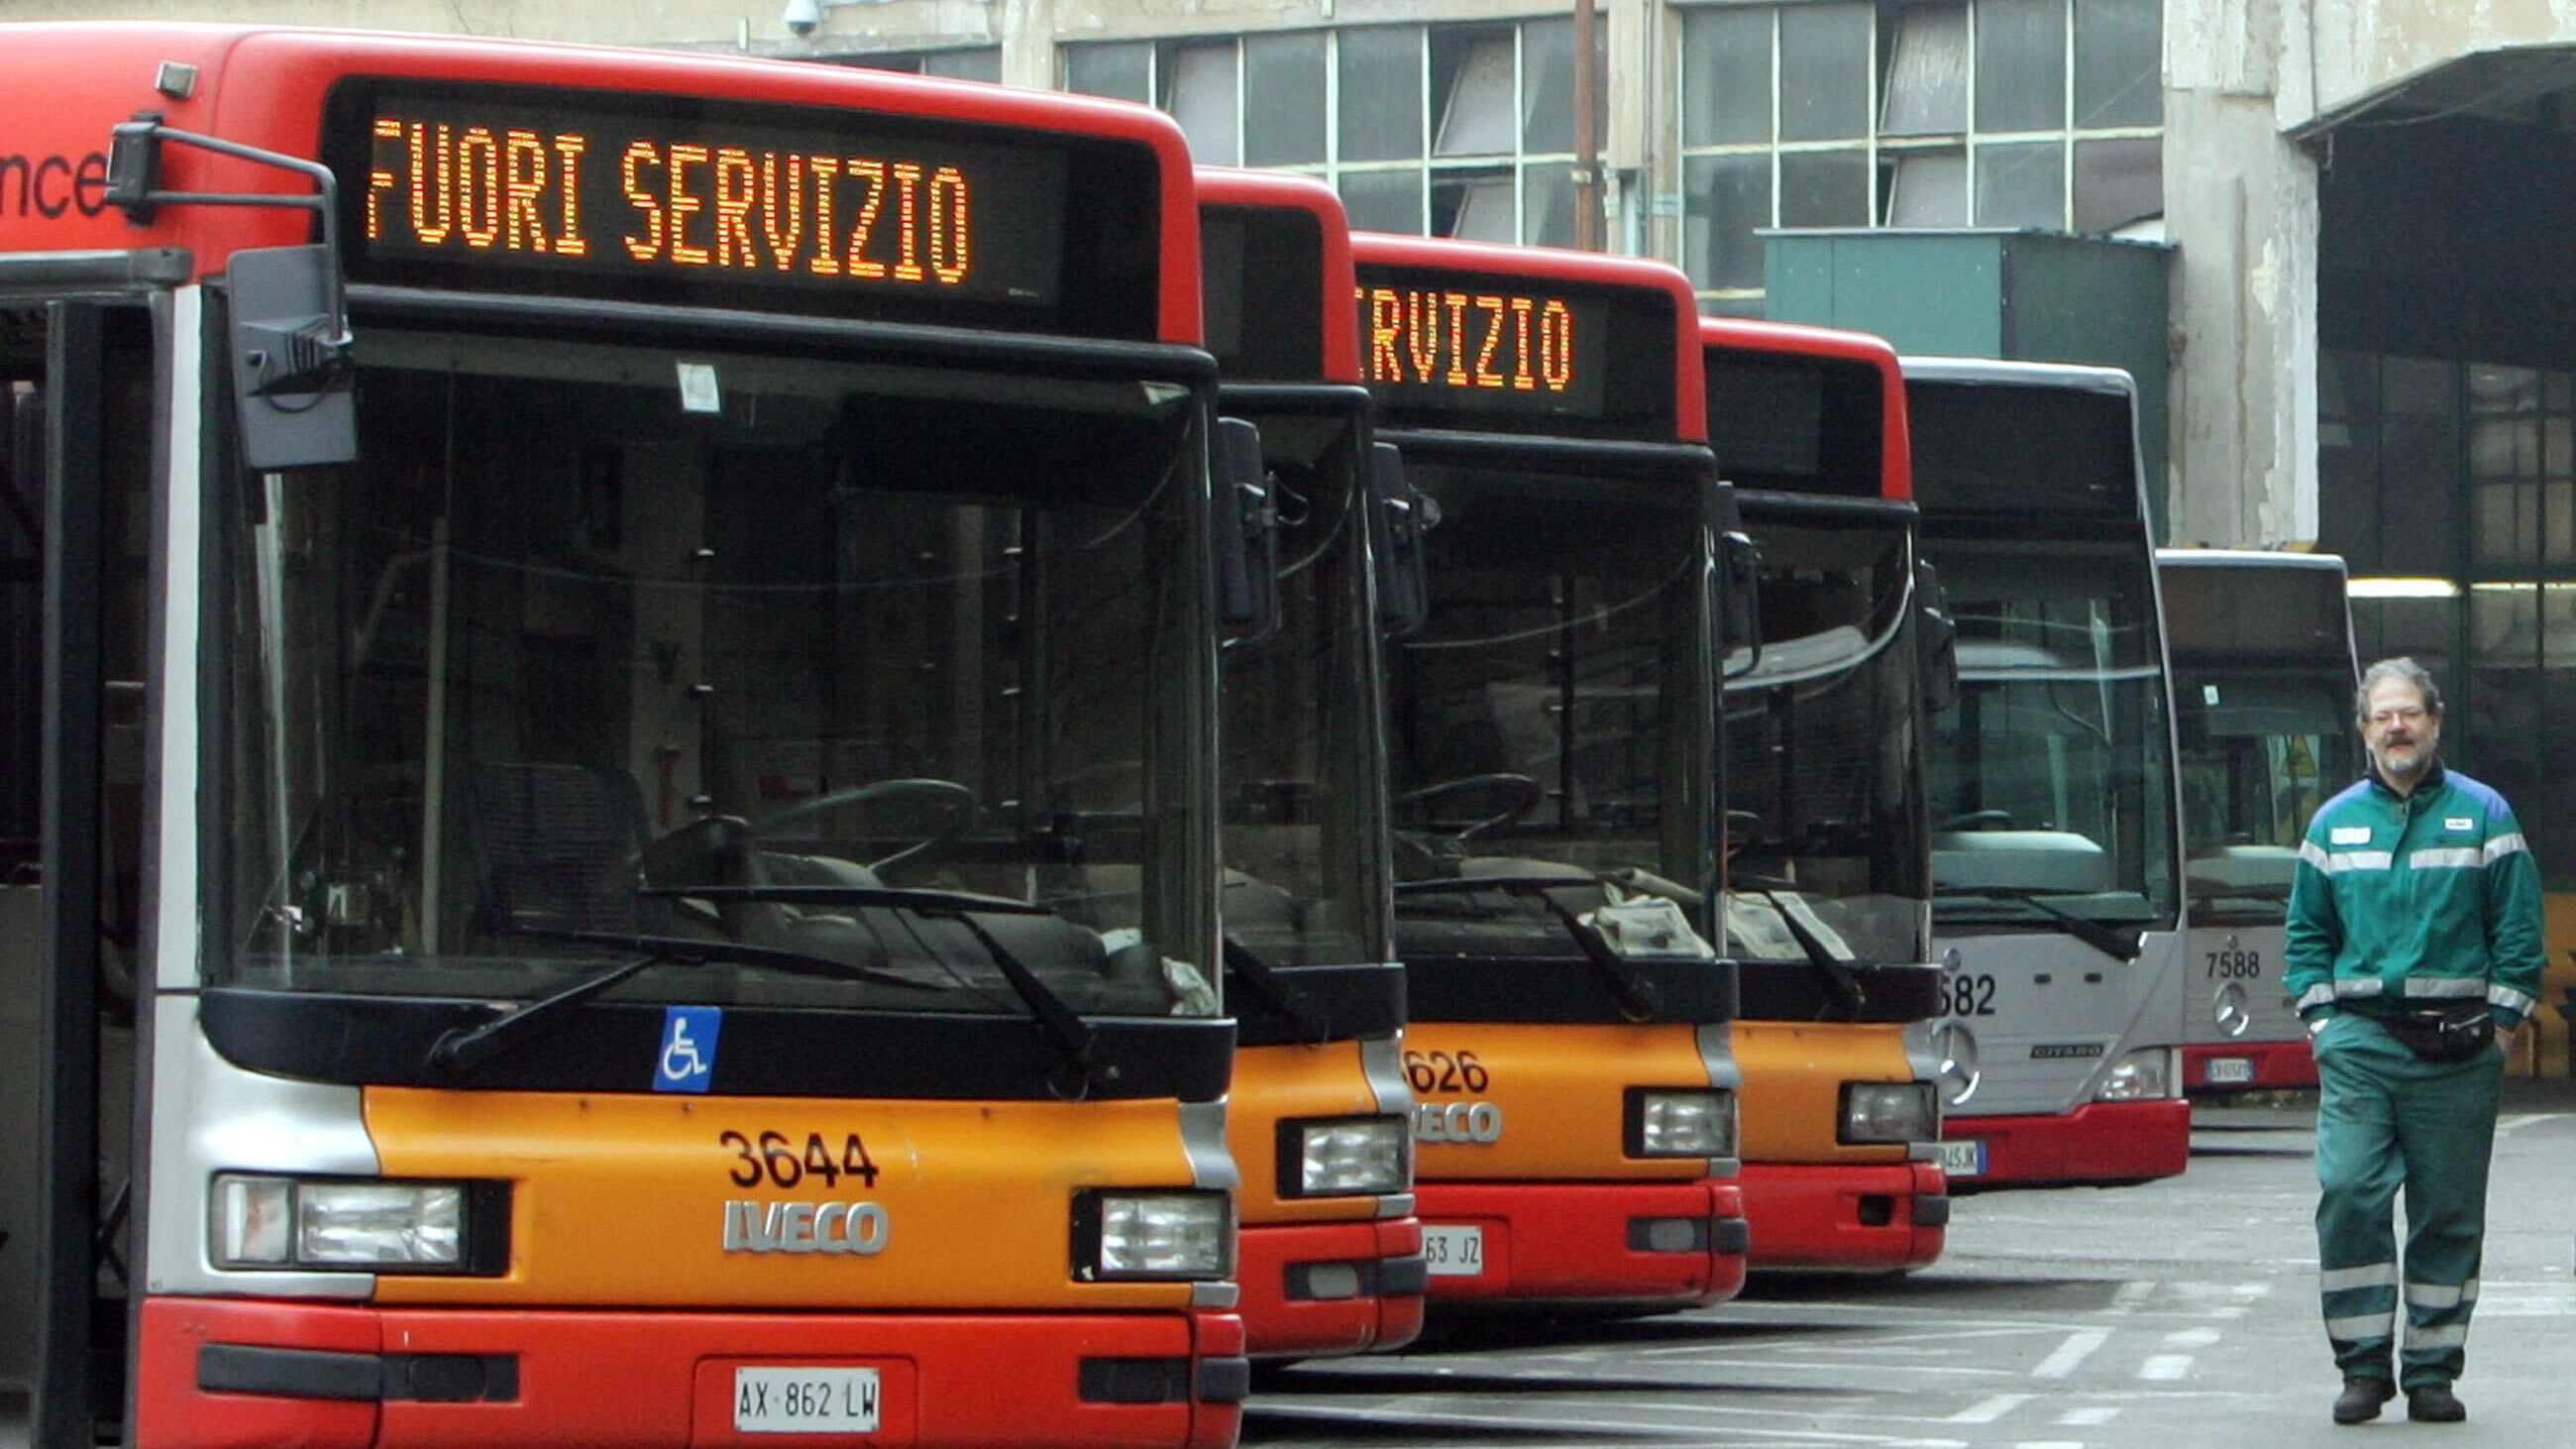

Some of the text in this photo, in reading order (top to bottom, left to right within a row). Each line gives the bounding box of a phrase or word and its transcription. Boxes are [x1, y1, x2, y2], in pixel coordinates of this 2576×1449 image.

[0, 152, 108, 218] nce
[368, 118, 970, 284] FUORI SERVIZIO
[1354, 286, 1573, 390] RVIZIO
[2205, 951, 2261, 979] 7588
[1402, 1051, 1489, 1094] 626
[719, 1130, 880, 1189] 3644
[723, 1200, 889, 1255] IVECO
[739, 1382, 877, 1417] AX 862 LW
